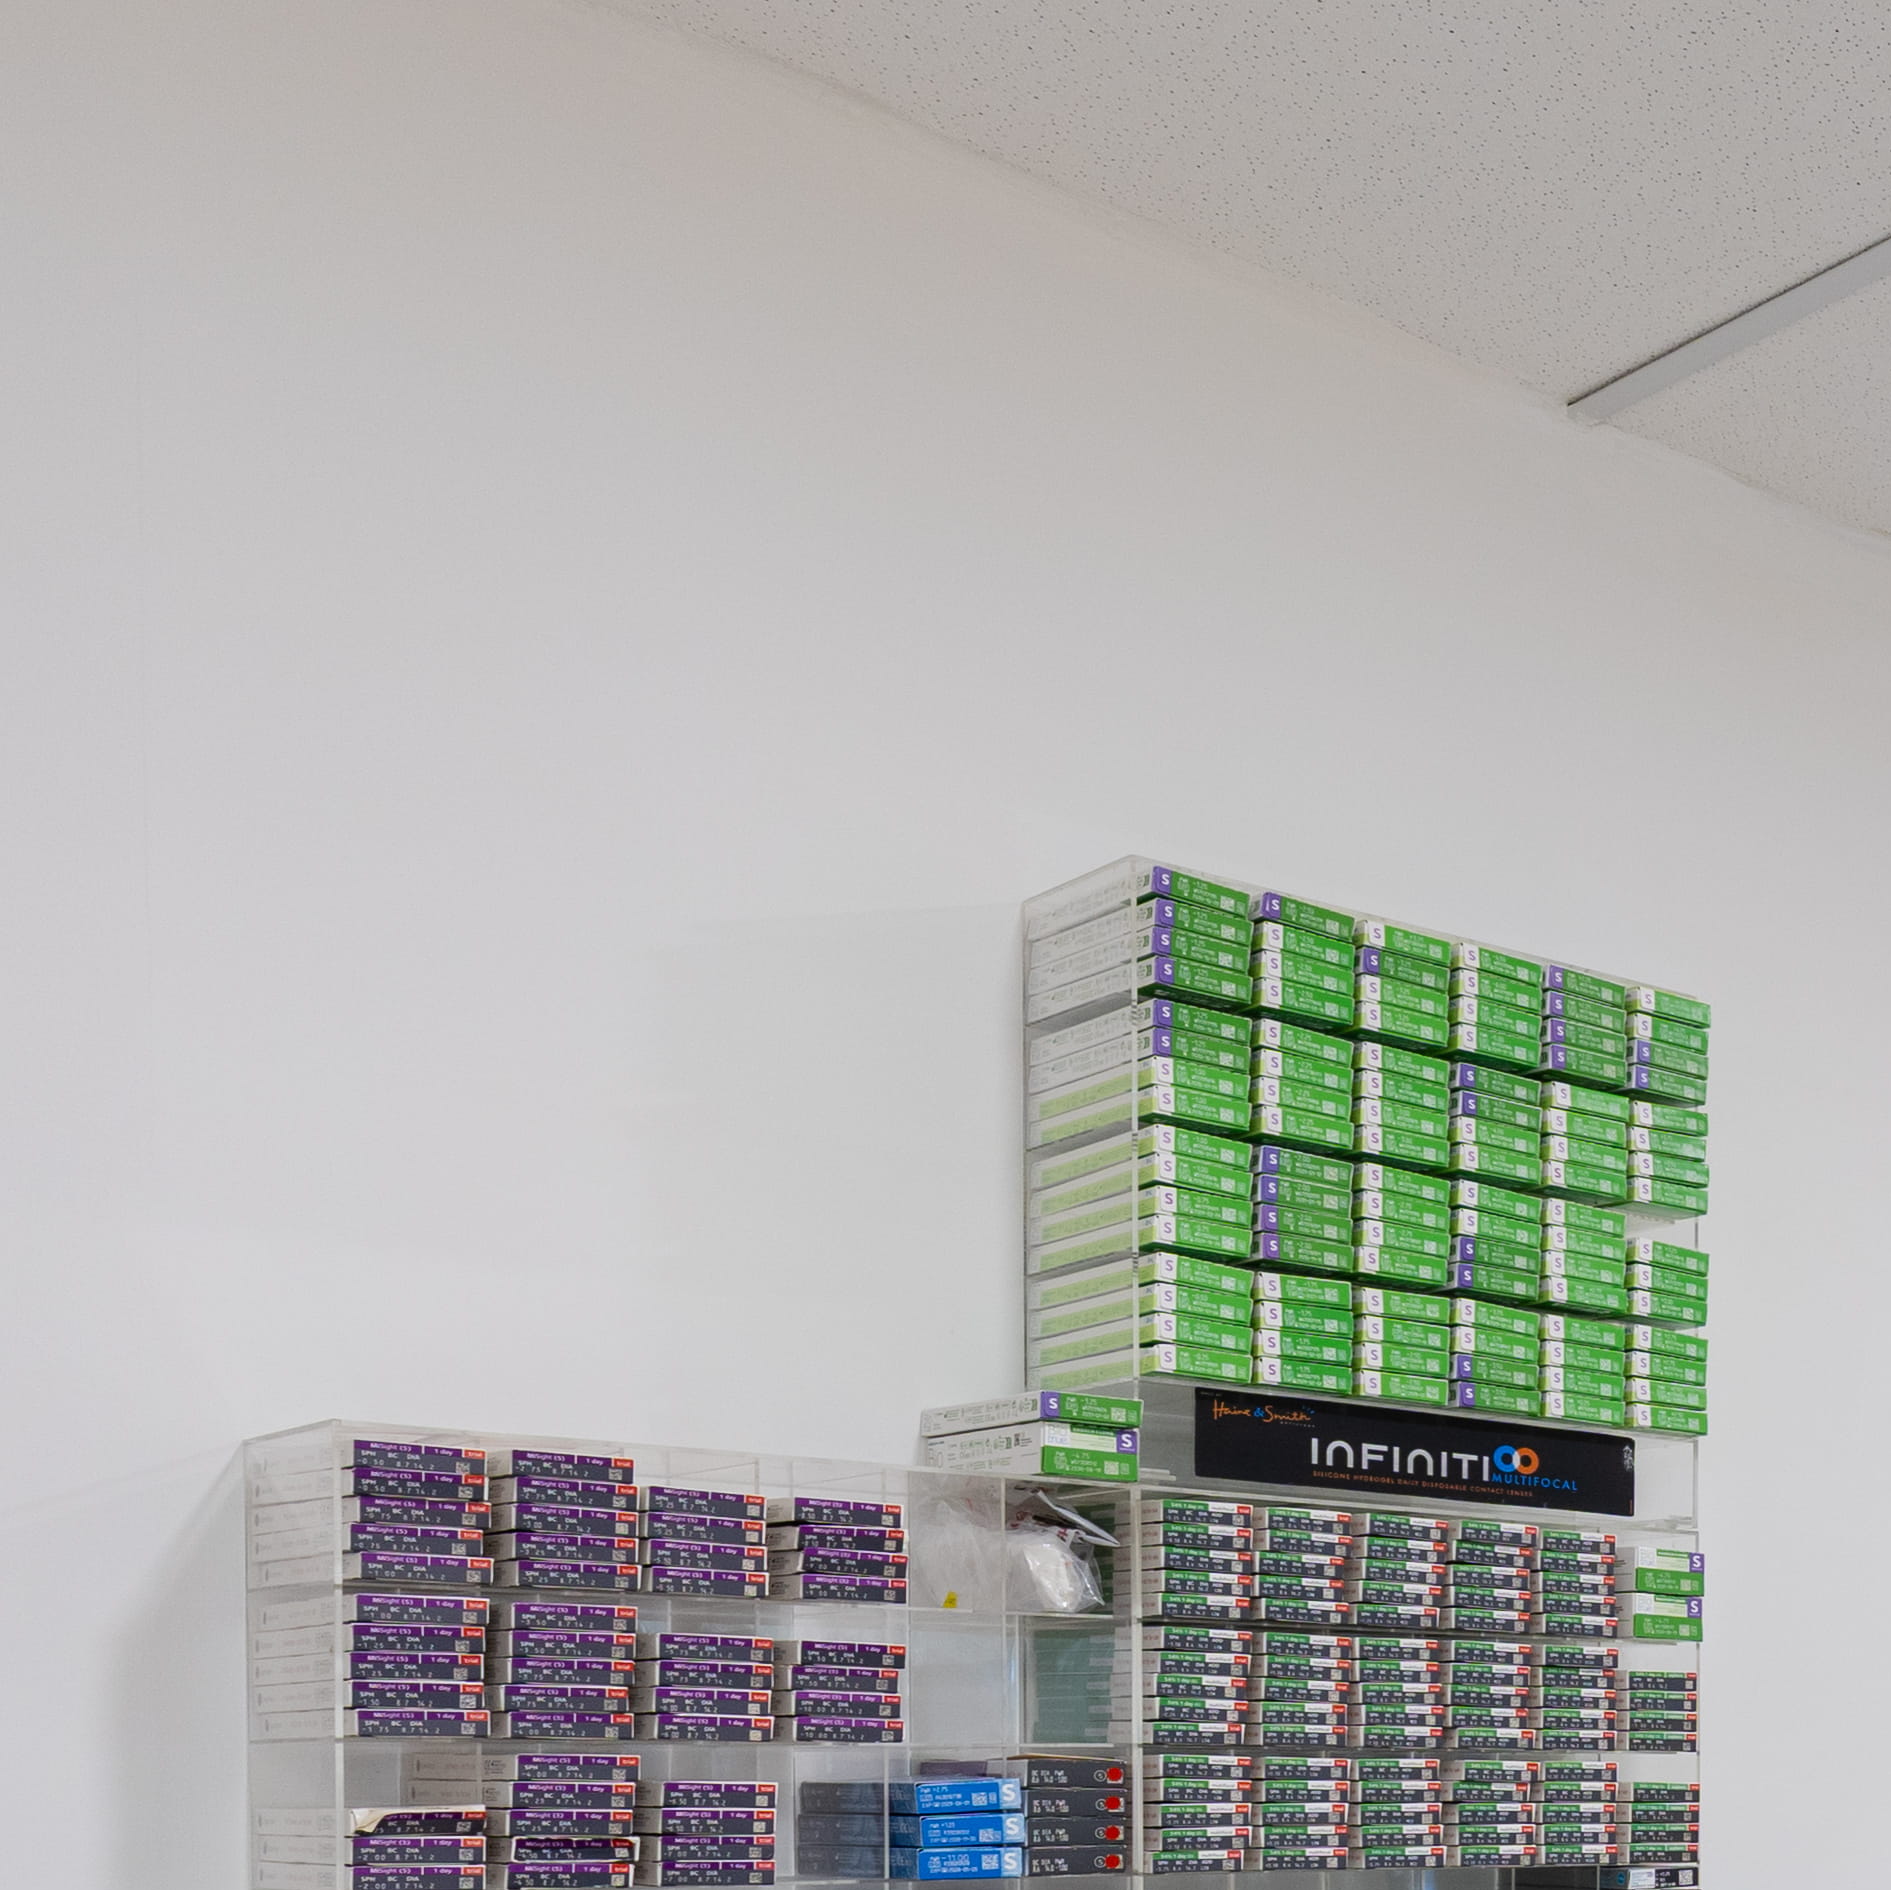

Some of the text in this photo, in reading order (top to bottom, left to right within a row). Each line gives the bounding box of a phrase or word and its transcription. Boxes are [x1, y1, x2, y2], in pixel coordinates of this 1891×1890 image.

[1161, 874, 1170, 885] S
[1272, 900, 1280, 910] S
[1049, 1398, 1058, 1409] S
[1254, 1407, 1264, 1417] &
[1121, 1434, 1133, 1447] S
[1313, 1471, 1351, 1480] SILICONE
[1397, 1478, 1419, 1486] DAILY
[1470, 1485, 1504, 1494] CONTACT
[1507, 1489, 1533, 1497] LENSES
[1492, 1473, 1578, 1491] MULTIFOCAL
[440, 1629, 453, 1637] day
[1002, 1784, 1015, 1800] S
[1005, 1817, 1019, 1834] S
[1004, 1852, 1018, 1870] S
